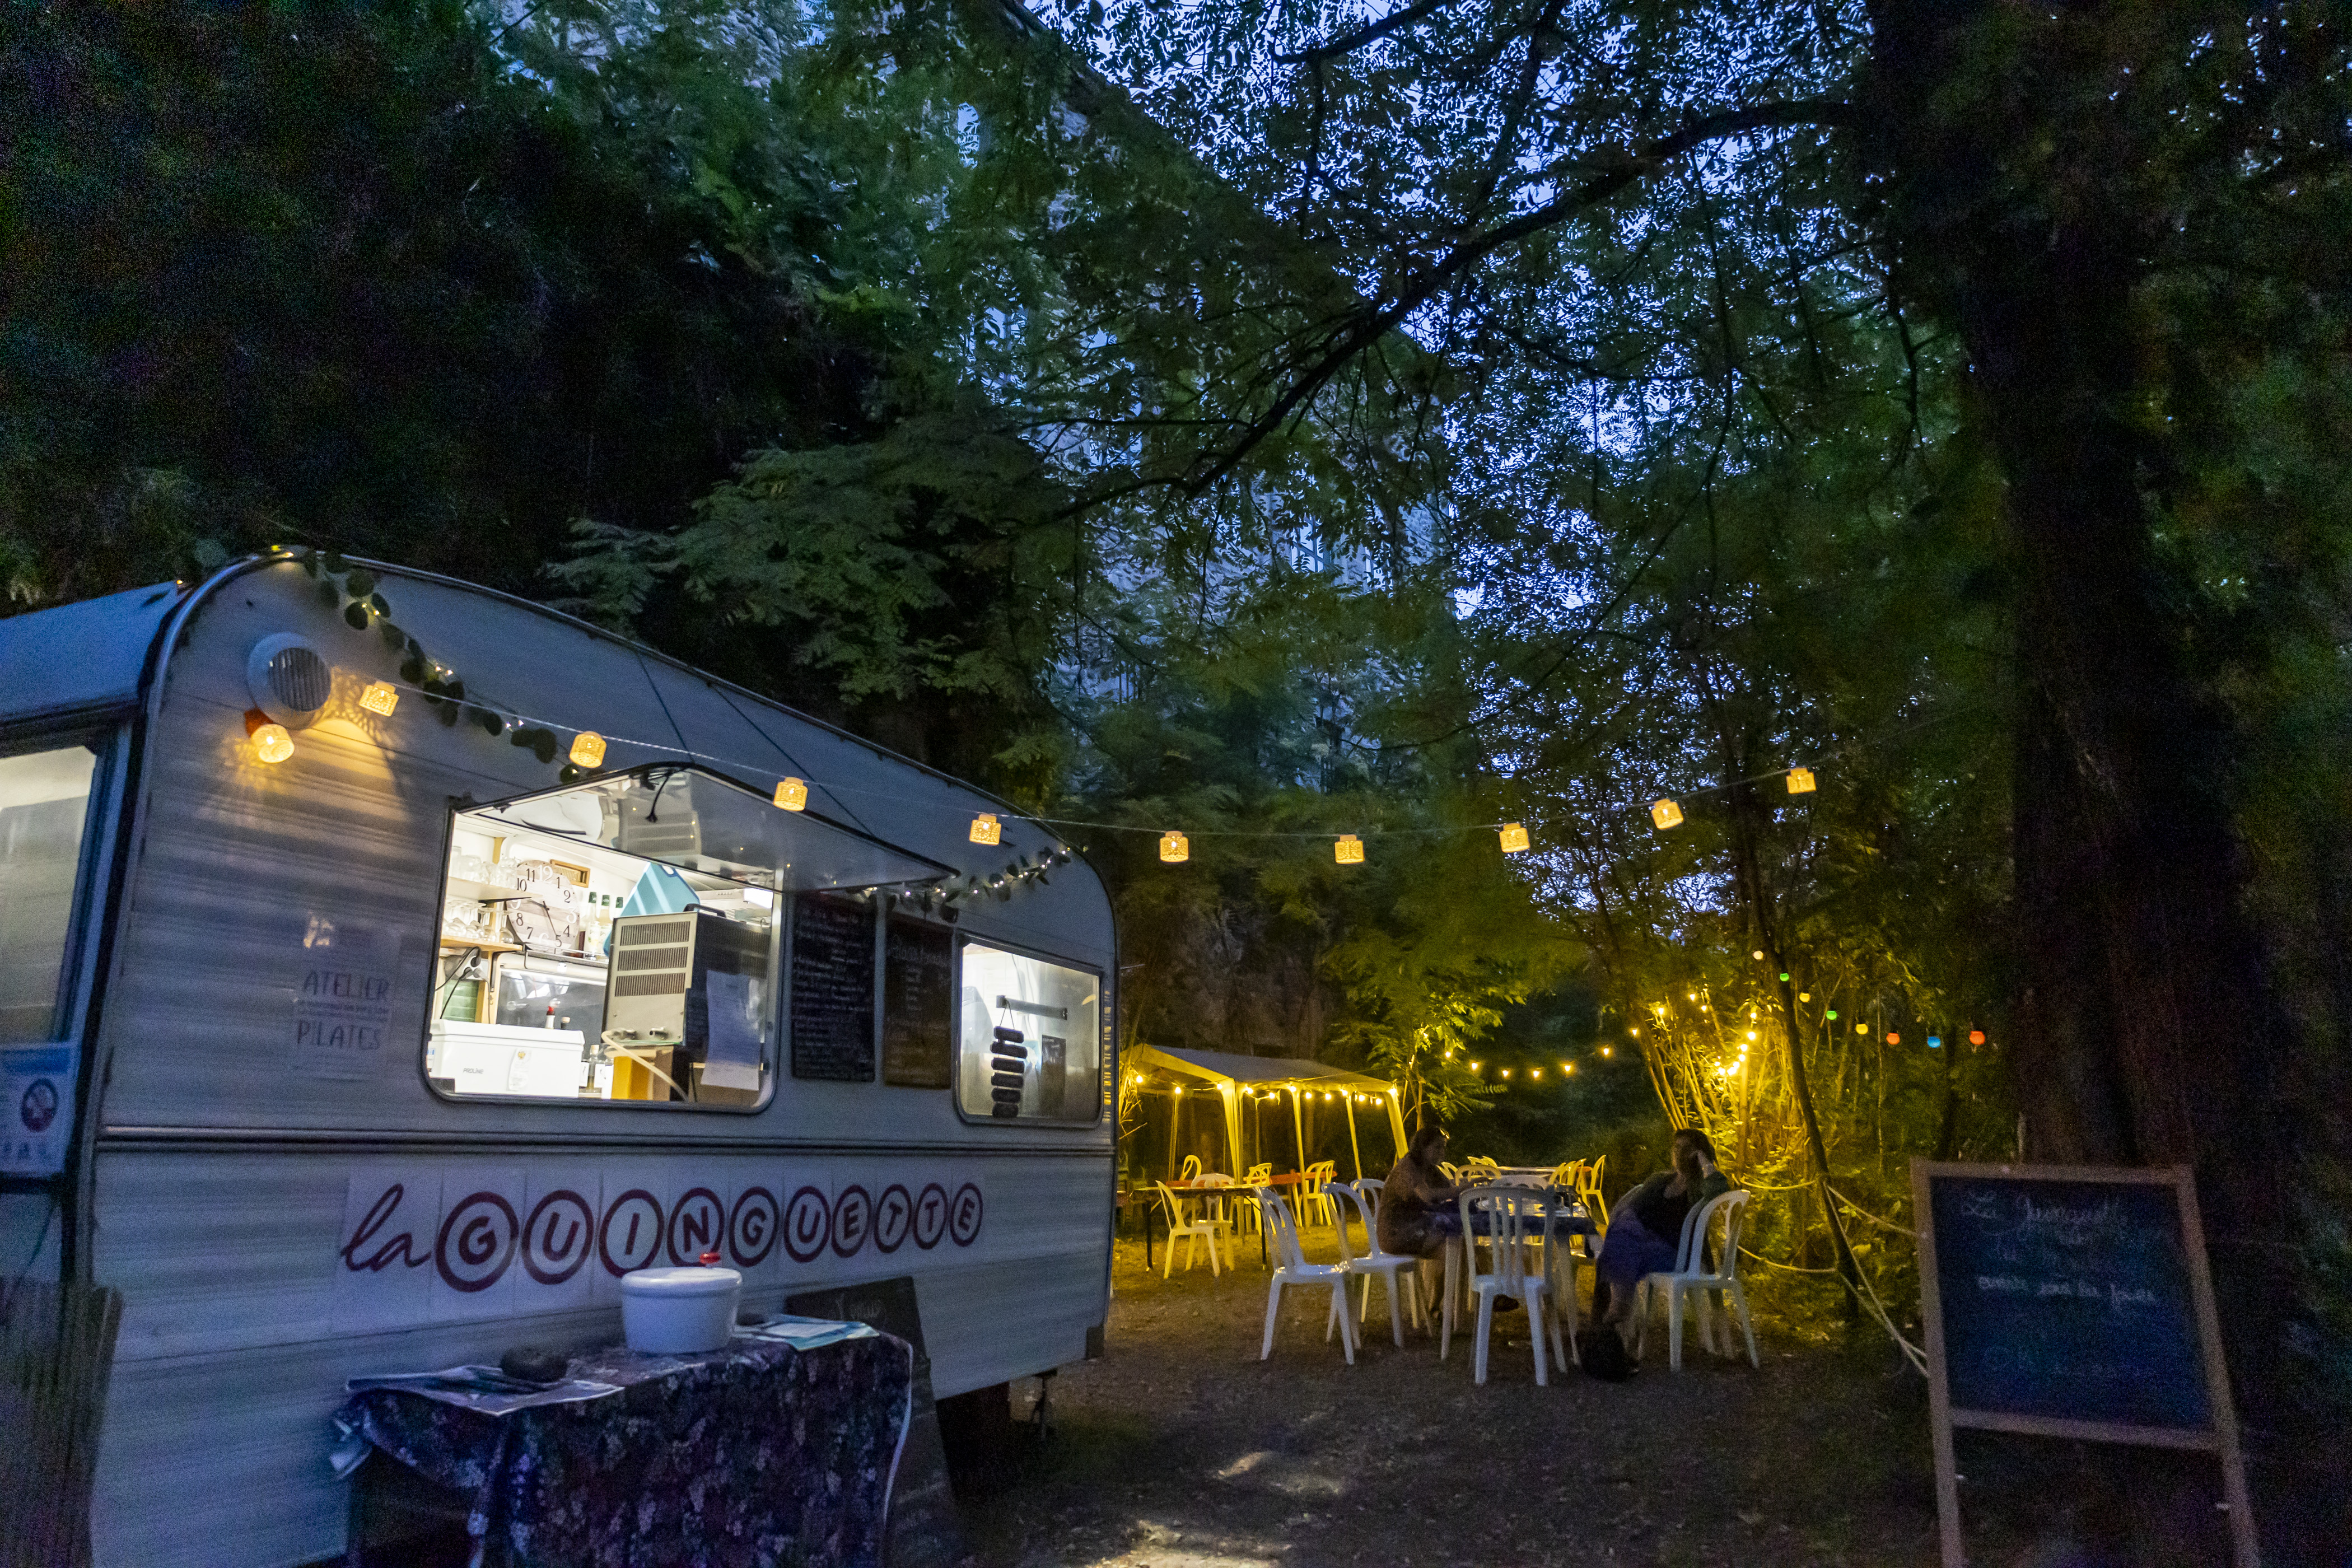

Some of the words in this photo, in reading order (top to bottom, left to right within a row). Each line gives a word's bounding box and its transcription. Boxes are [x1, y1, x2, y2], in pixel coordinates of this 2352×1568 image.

[526, 869, 535, 882] 11
[538, 865, 553, 883] 12
[517, 878, 527, 892] 10
[557, 876, 560, 888] 1
[564, 890, 571, 903] 2
[516, 913, 524, 926] 8
[566, 907, 577, 923] 3
[527, 927, 534, 939] 7
[563, 925, 570, 937] 4
[555, 934, 562, 947] 5
[303, 970, 389, 1001] ATELIER
[296, 1019, 382, 1051] PILATES
[340, 1183, 432, 1271] la
[458, 1195, 975, 1265] GUINGUETTE
